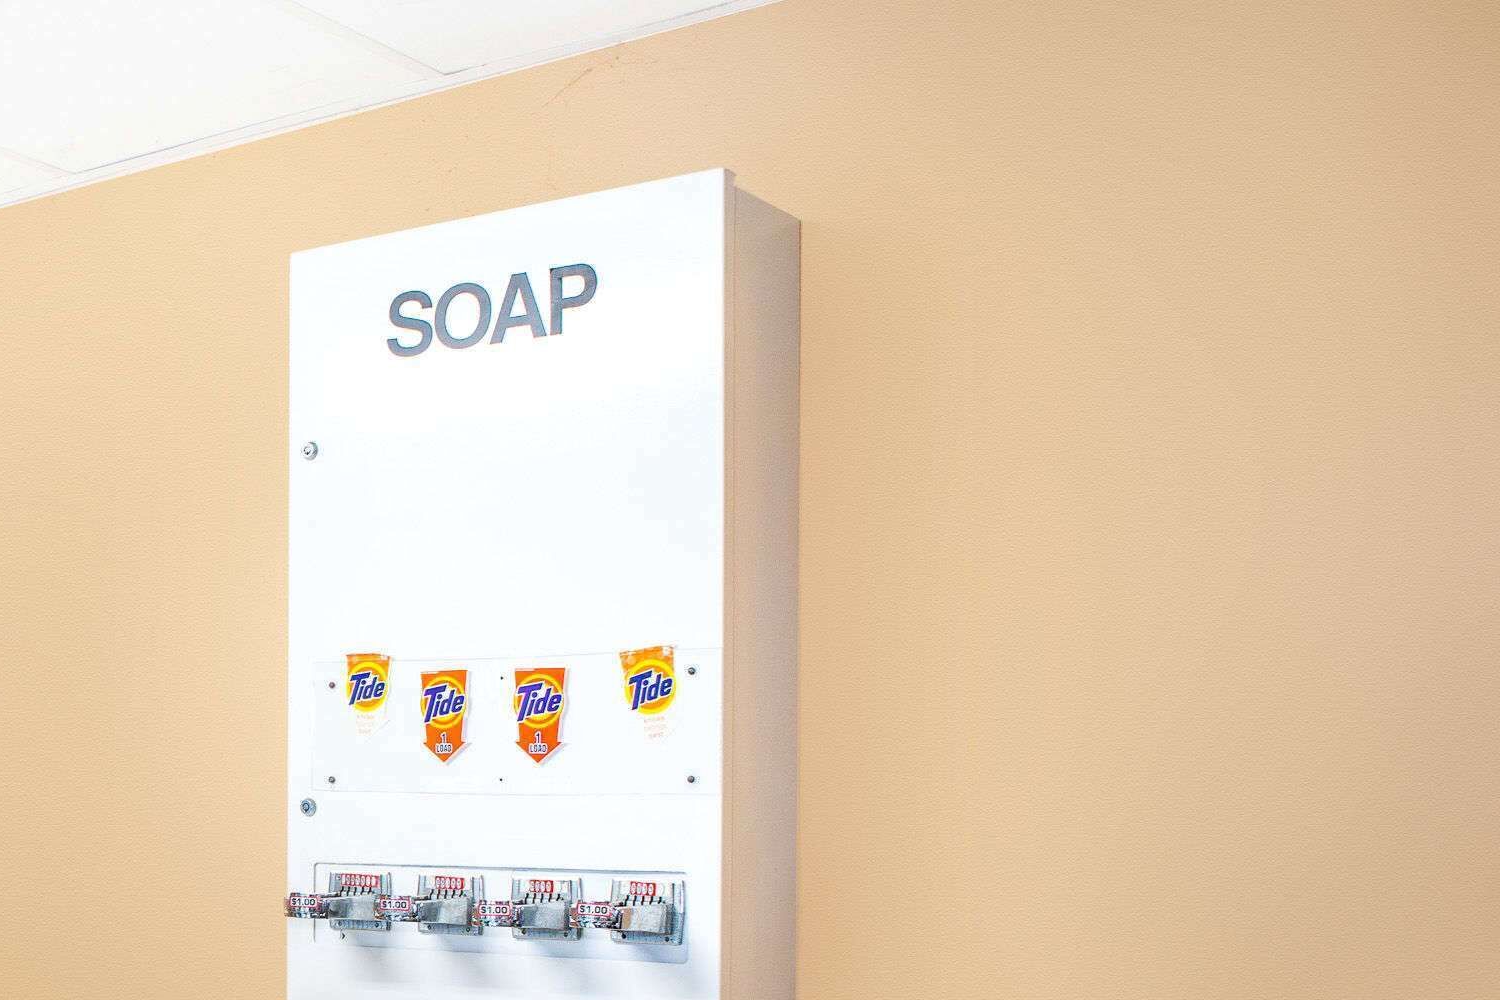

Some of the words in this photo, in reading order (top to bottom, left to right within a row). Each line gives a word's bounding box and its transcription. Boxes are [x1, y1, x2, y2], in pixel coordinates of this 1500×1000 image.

[386, 263, 598, 357] SOAP
[348, 671, 386, 706] Tide
[628, 669, 673, 711] Tide
[423, 684, 465, 723] Tide
[516, 682, 562, 722] Tide
[440, 733, 447, 744] 1
[534, 732, 542, 744] 1
[436, 744, 453, 753] LOAD
[529, 744, 548, 753] LOAD
[290, 897, 316, 906] $1.00
[381, 900, 407, 909] $1.00
[480, 906, 508, 915] $1.00
[578, 905, 608, 915] $1.00
